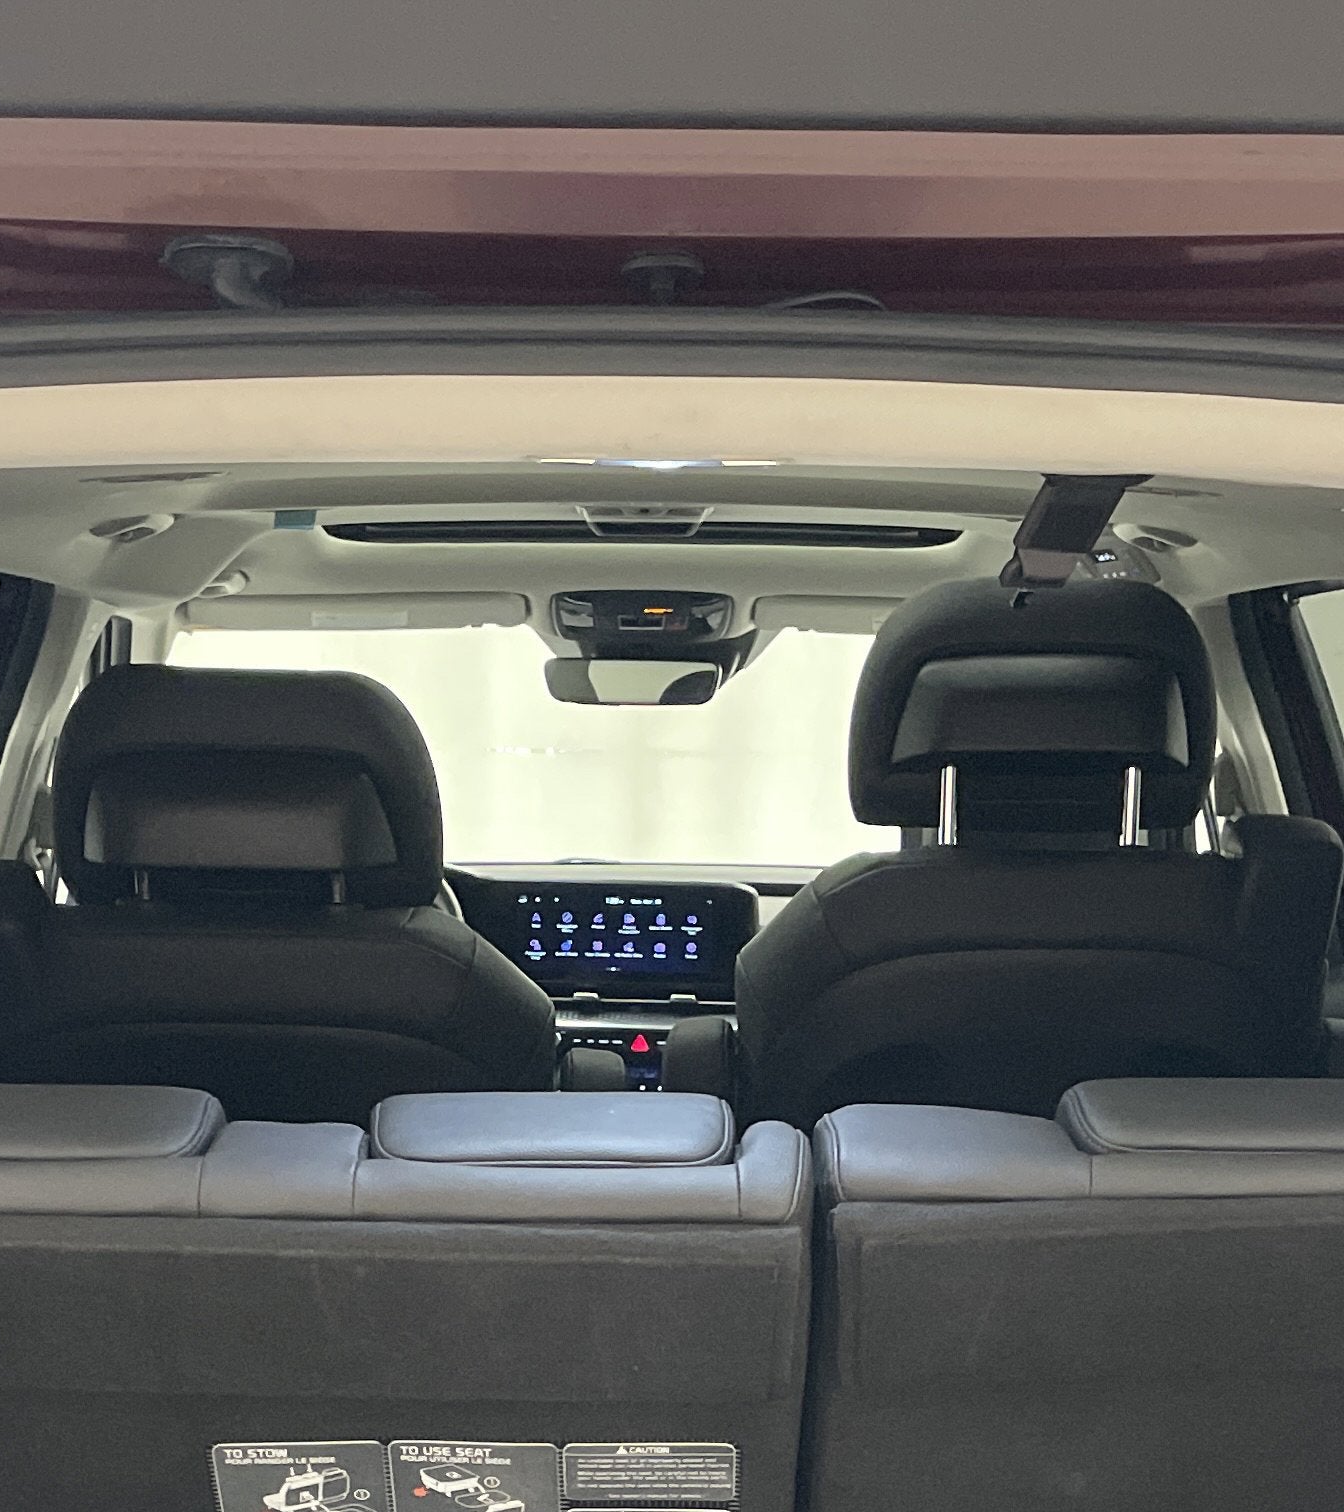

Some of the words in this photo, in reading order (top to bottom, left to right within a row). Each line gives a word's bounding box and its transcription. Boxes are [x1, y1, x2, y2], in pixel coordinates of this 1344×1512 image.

[223, 1449, 243, 1459] TO
[247, 1448, 288, 1459] STOW
[399, 1446, 419, 1455] TO
[423, 1446, 451, 1457] USE
[455, 1447, 492, 1458] SEAT
[629, 1446, 670, 1454] CAUTION
[471, 1457, 483, 1465] LE
